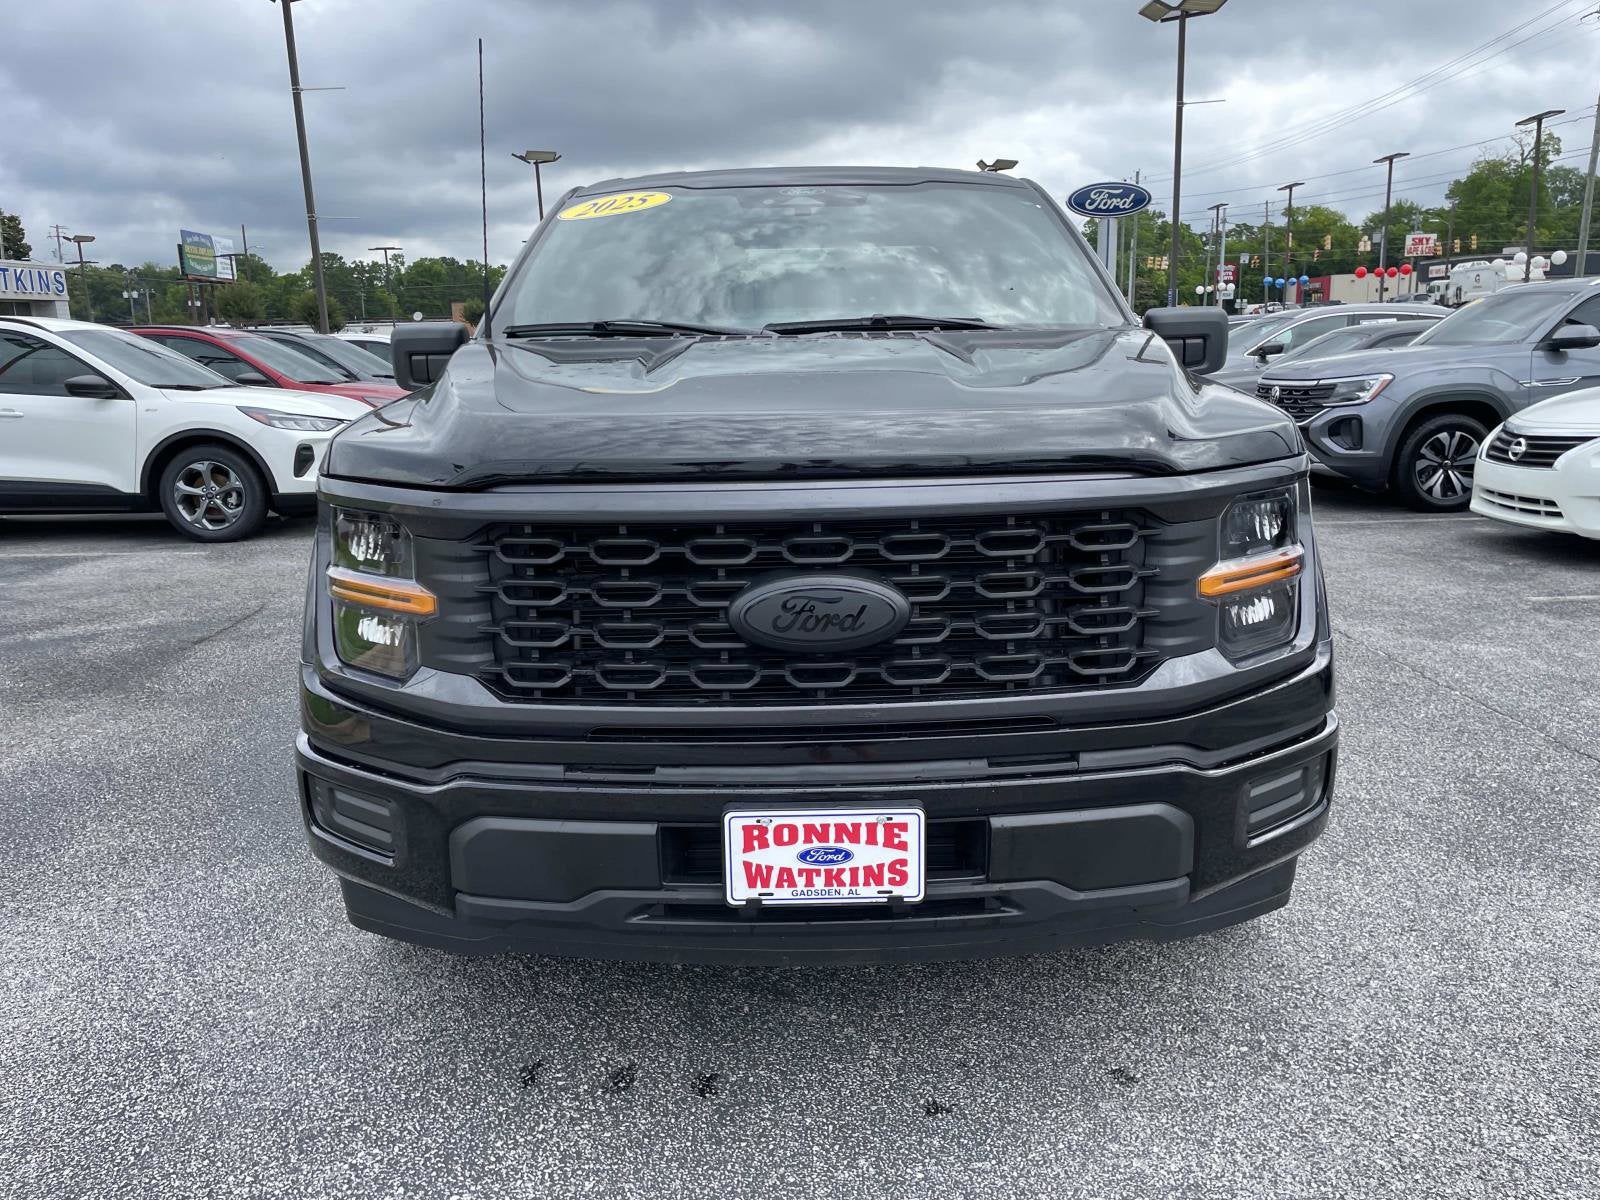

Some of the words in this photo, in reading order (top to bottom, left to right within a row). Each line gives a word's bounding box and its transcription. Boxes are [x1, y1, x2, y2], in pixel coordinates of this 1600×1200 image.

[574, 194, 655, 217] 2025
[1085, 188, 1136, 210] Ford
[1411, 236, 1432, 246] SKY
[771, 595, 868, 633] Ford
[741, 822, 909, 854] RONNIE
[806, 848, 845, 862] Ford
[742, 858, 909, 889] WATKINS
[791, 888, 844, 897] GADSDEN,
[847, 888, 861, 896] AL
